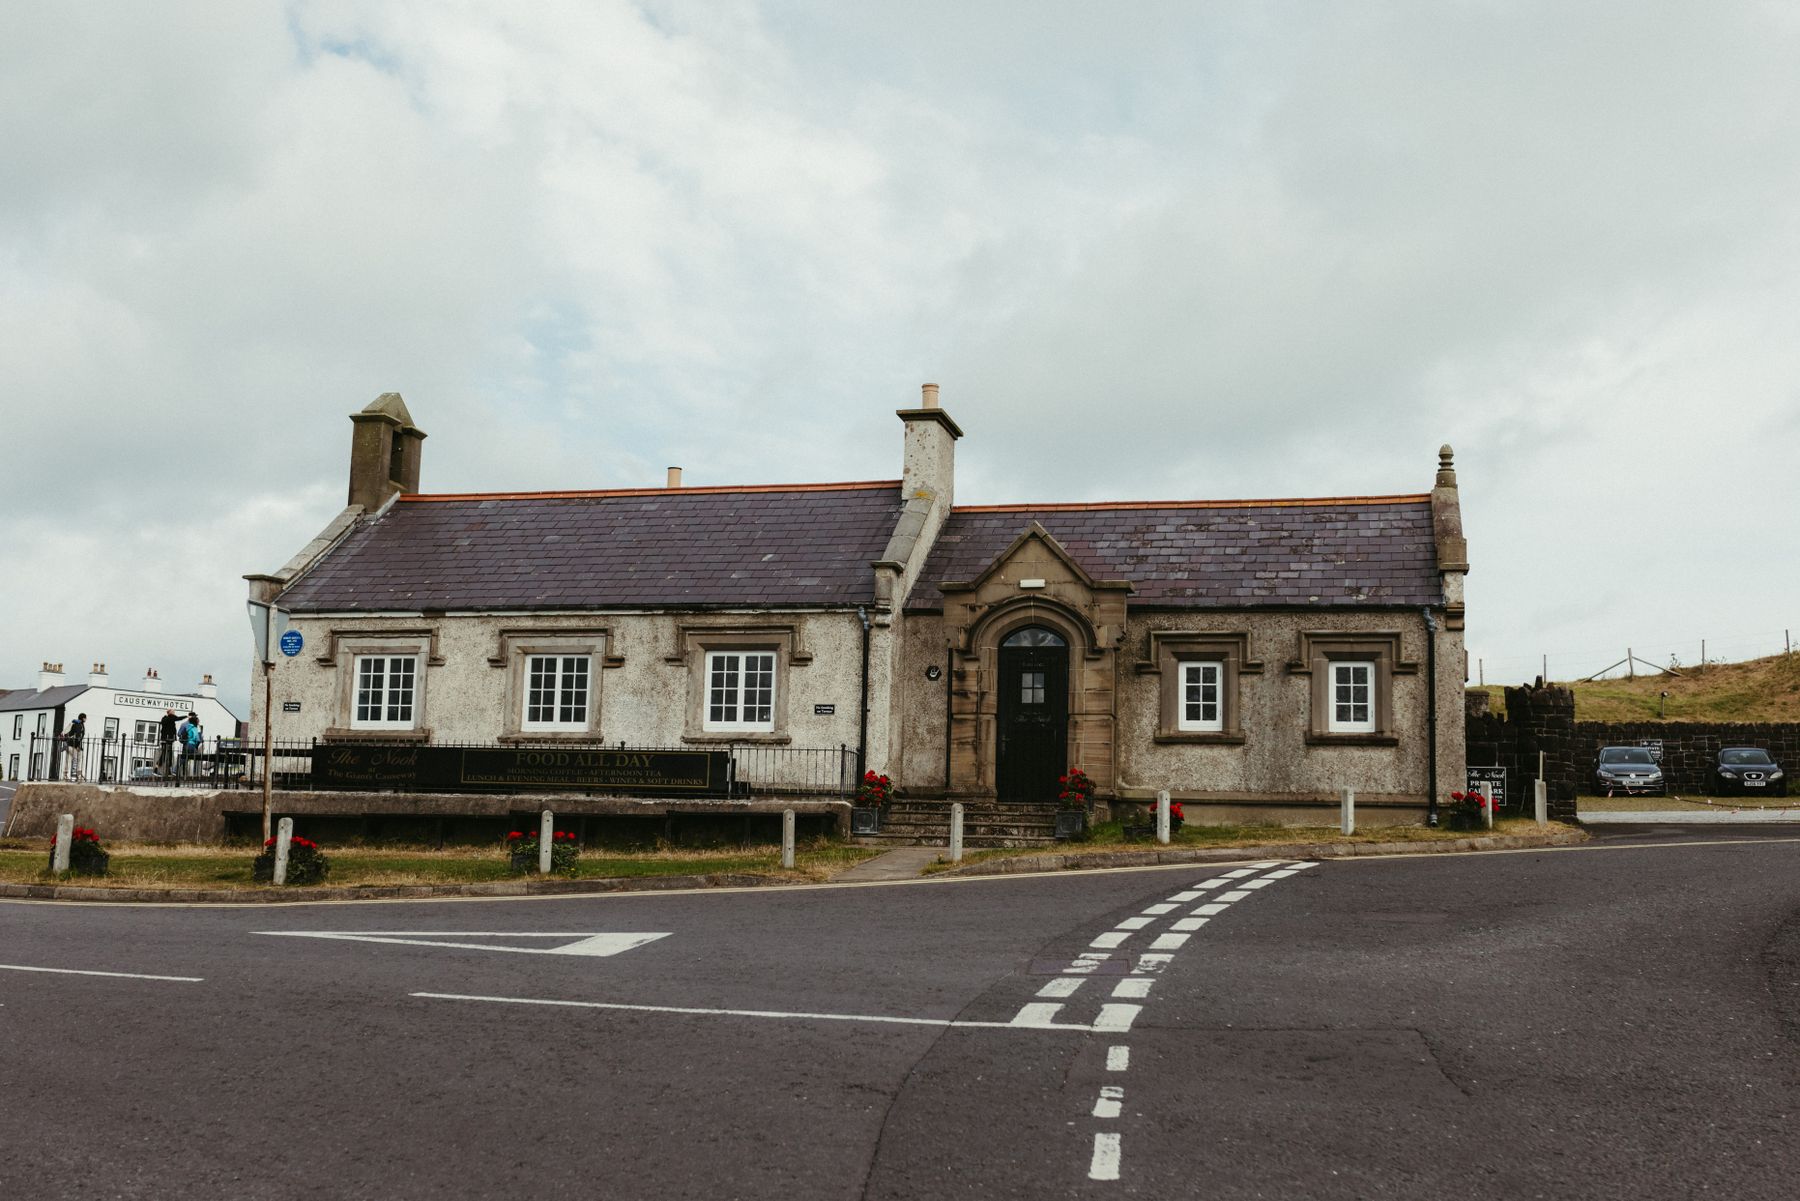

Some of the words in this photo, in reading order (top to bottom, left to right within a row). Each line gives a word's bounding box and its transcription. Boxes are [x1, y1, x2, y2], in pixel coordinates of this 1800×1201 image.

[119, 696, 161, 706] CAUSEWAY
[164, 701, 189, 710] HOTEL
[328, 748, 360, 765] The
[370, 748, 418, 766] Nook
[516, 752, 569, 766] FOOD
[574, 753, 610, 767] ALL
[615, 754, 655, 768] DAY
[328, 769, 344, 777] The
[590, 769, 643, 777] AFTERNOON
